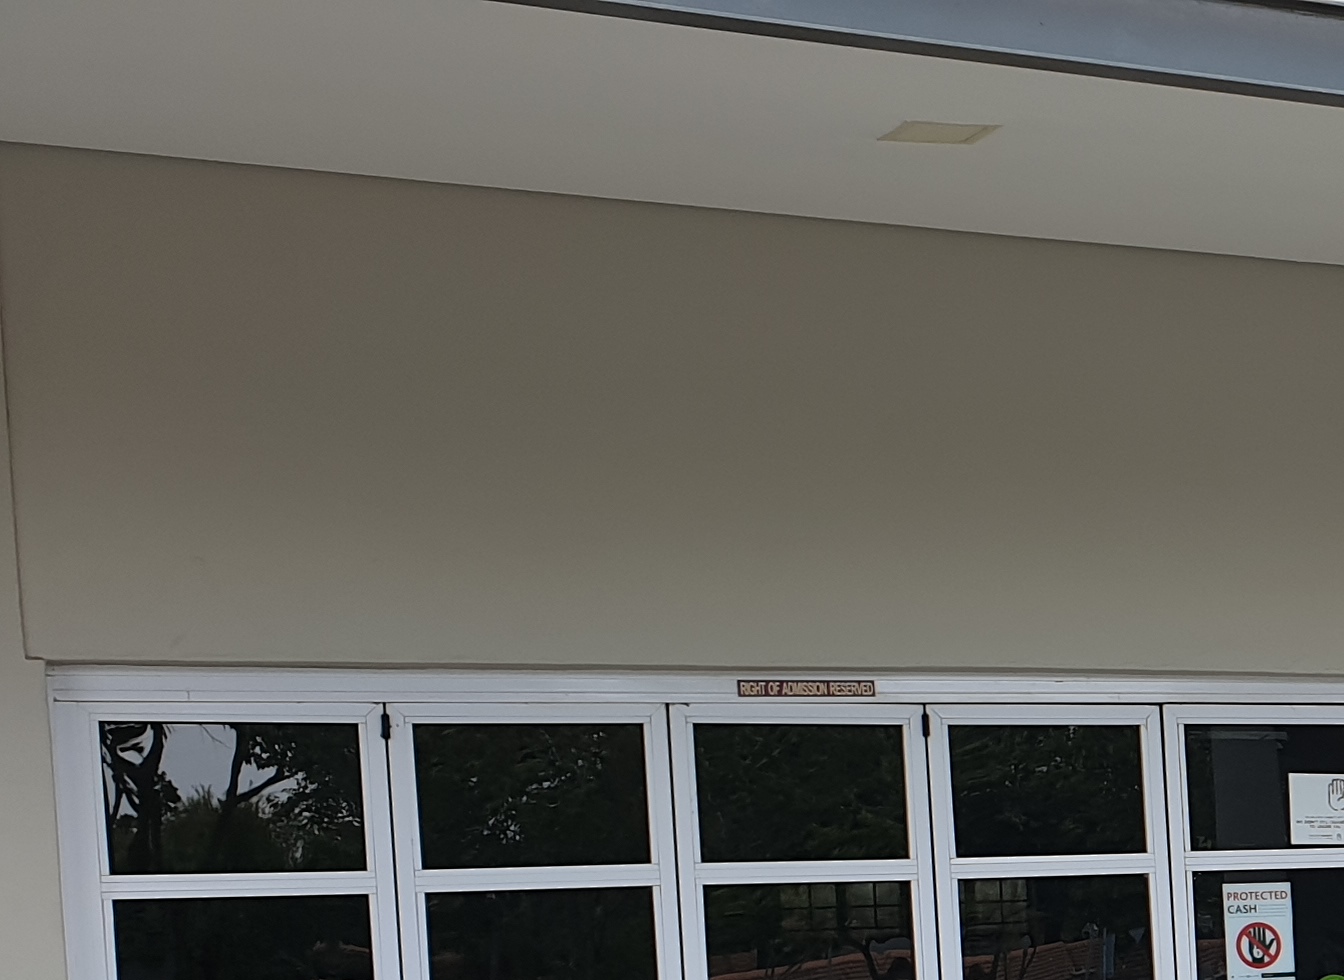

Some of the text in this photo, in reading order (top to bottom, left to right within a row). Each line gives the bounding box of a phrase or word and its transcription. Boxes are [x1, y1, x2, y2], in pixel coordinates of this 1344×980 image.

[740, 682, 874, 695] RIGHT OF ADMISSION RESERVED
[1227, 890, 1288, 901] PROTECTED
[1227, 904, 1257, 914] CASH
